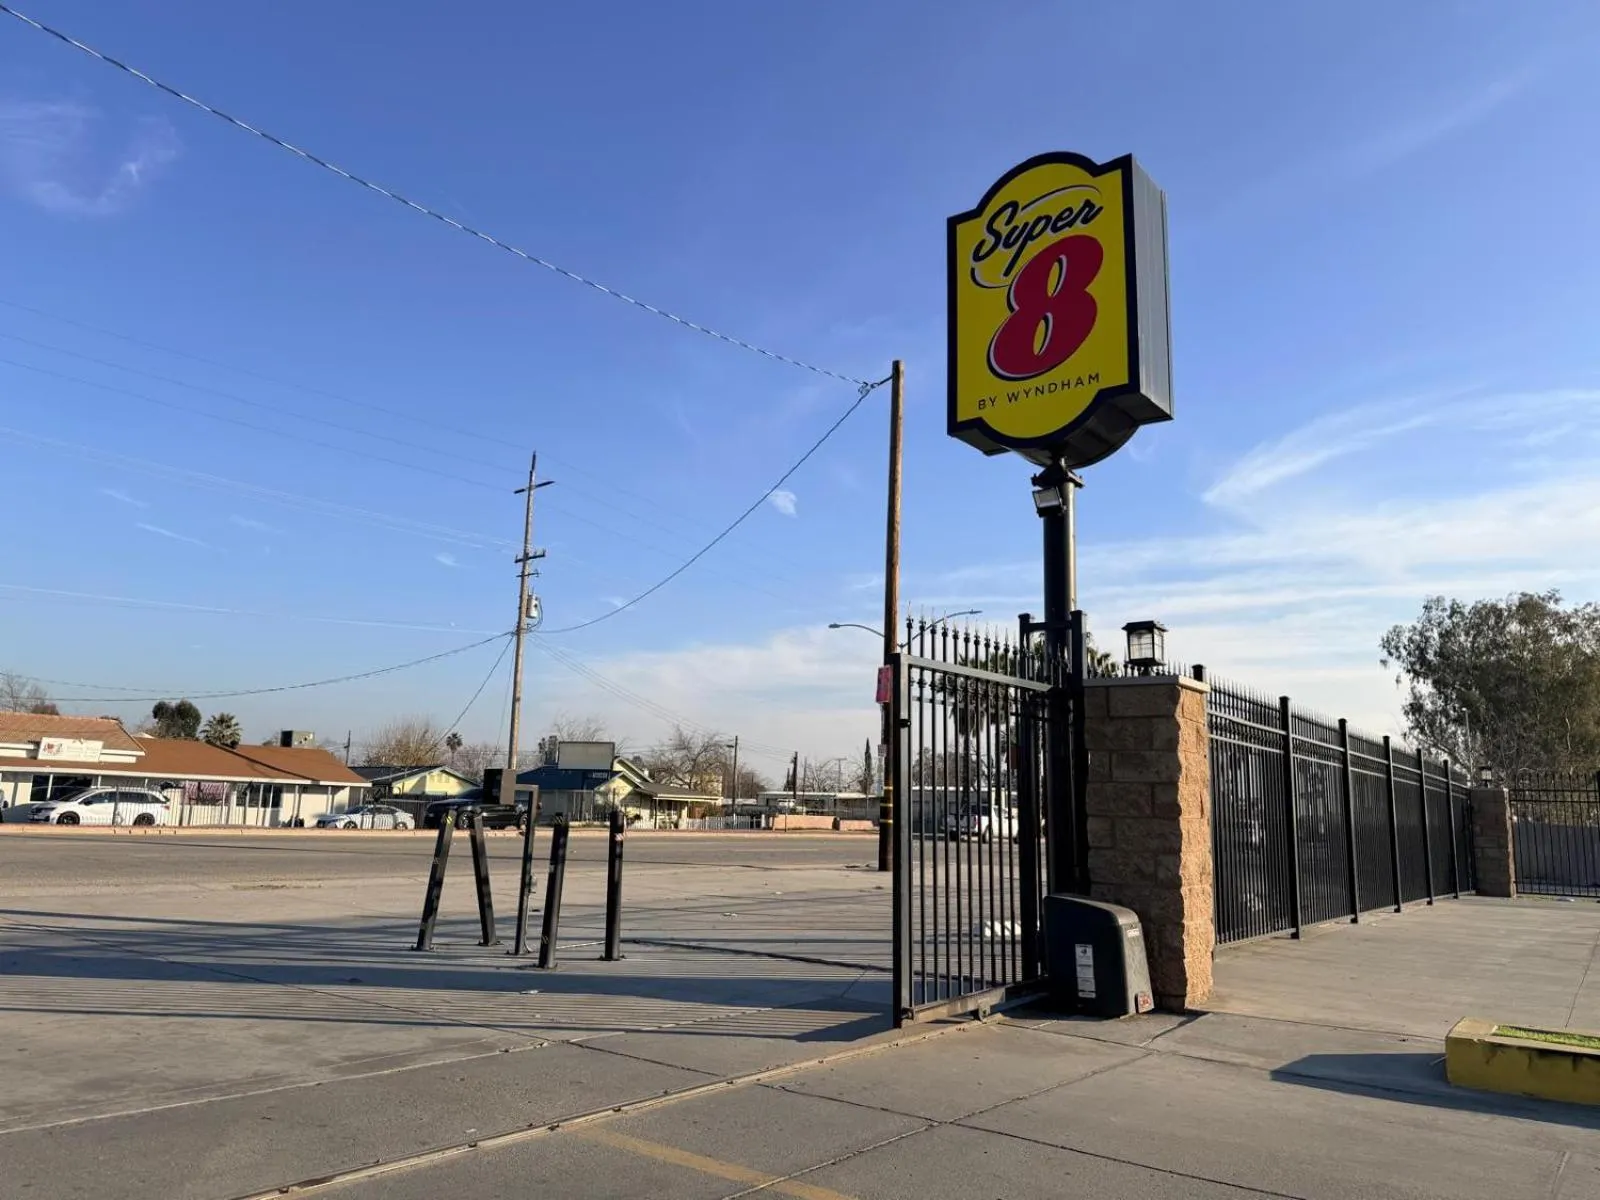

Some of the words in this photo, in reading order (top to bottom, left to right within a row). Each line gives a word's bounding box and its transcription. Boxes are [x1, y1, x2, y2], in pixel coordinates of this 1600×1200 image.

[972, 199, 1104, 277] Super
[986, 234, 1104, 382] 8
[978, 396, 998, 410] BY
[1006, 373, 1100, 403] WYNDHAM
